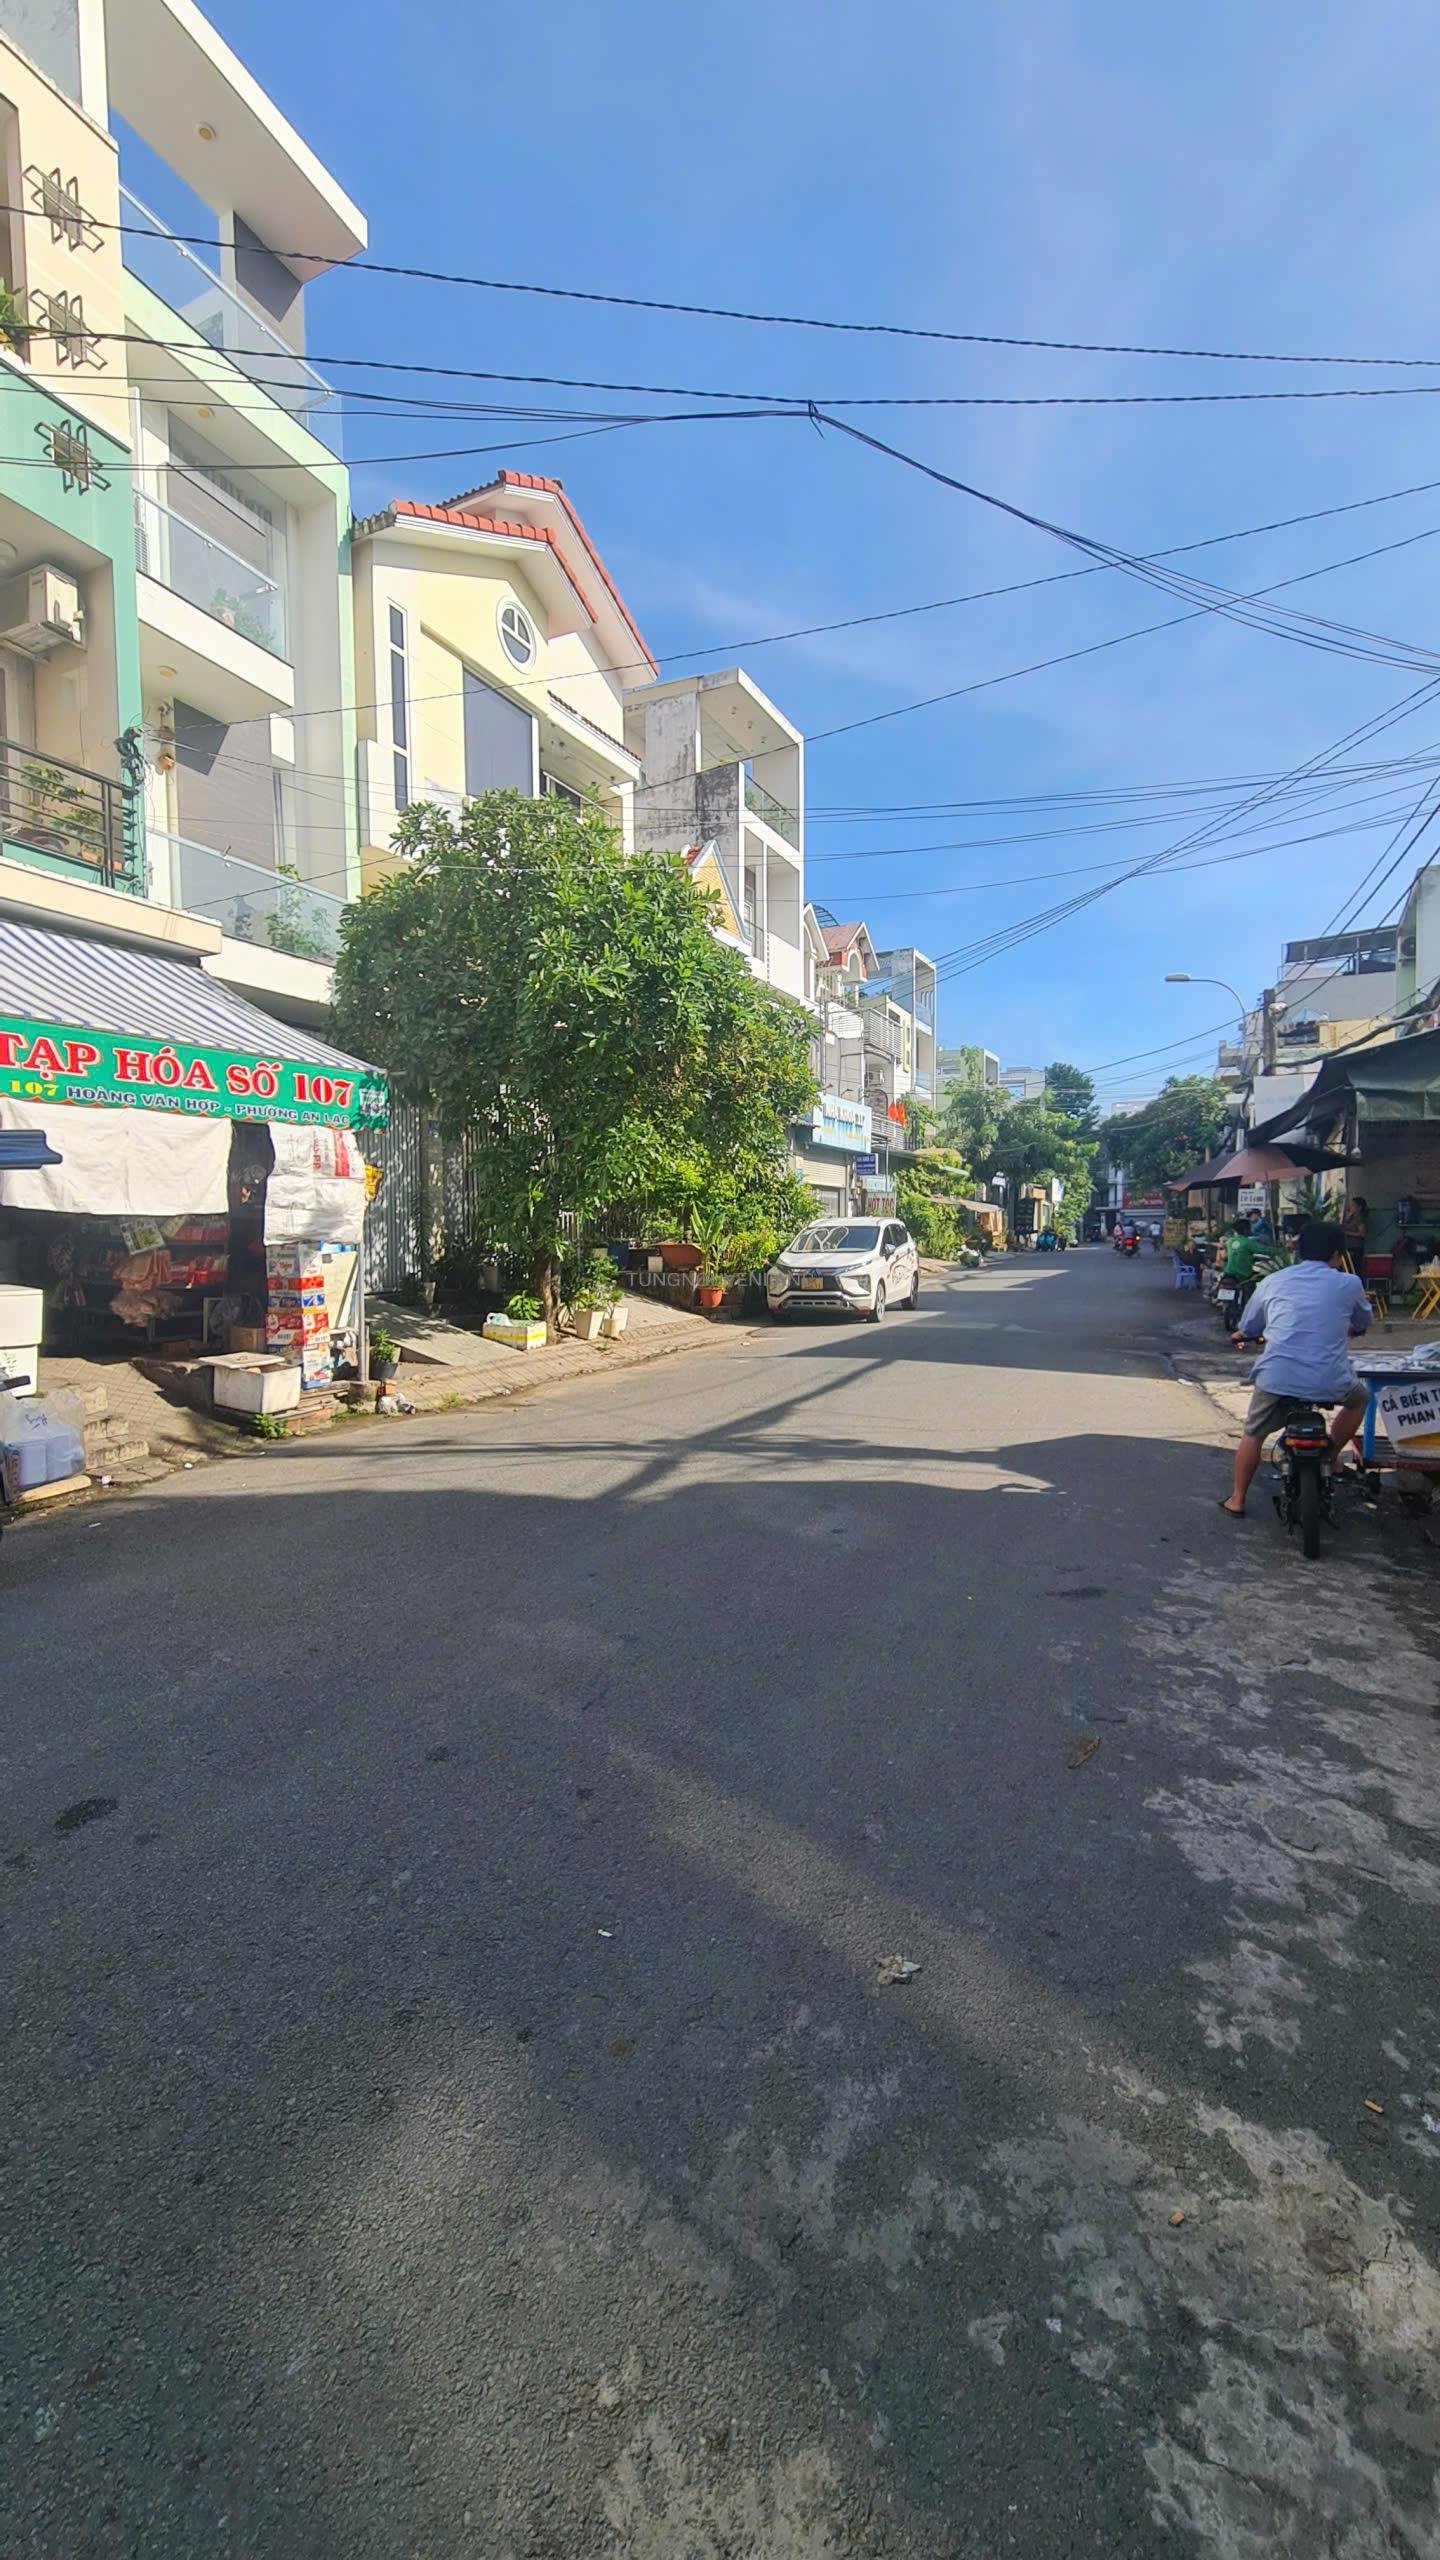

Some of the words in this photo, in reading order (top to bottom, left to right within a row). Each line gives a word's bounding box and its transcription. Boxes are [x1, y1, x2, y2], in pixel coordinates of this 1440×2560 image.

[0, 1031, 101, 1080] TẠP
[112, 1045, 218, 1091] HÓA
[227, 1060, 282, 1098] SỐ
[293, 1072, 354, 1108] 107
[9, 1080, 59, 1096] 107
[66, 1085, 136, 1104] HOÀNG
[185, 1097, 220, 1113] HỢP
[302, 1111, 320, 1123] AN
[1382, 1393, 1399, 1412] CÁ
[1400, 1386, 1430, 1408] BIỂN
[1397, 1409, 1436, 1426] PHAN
